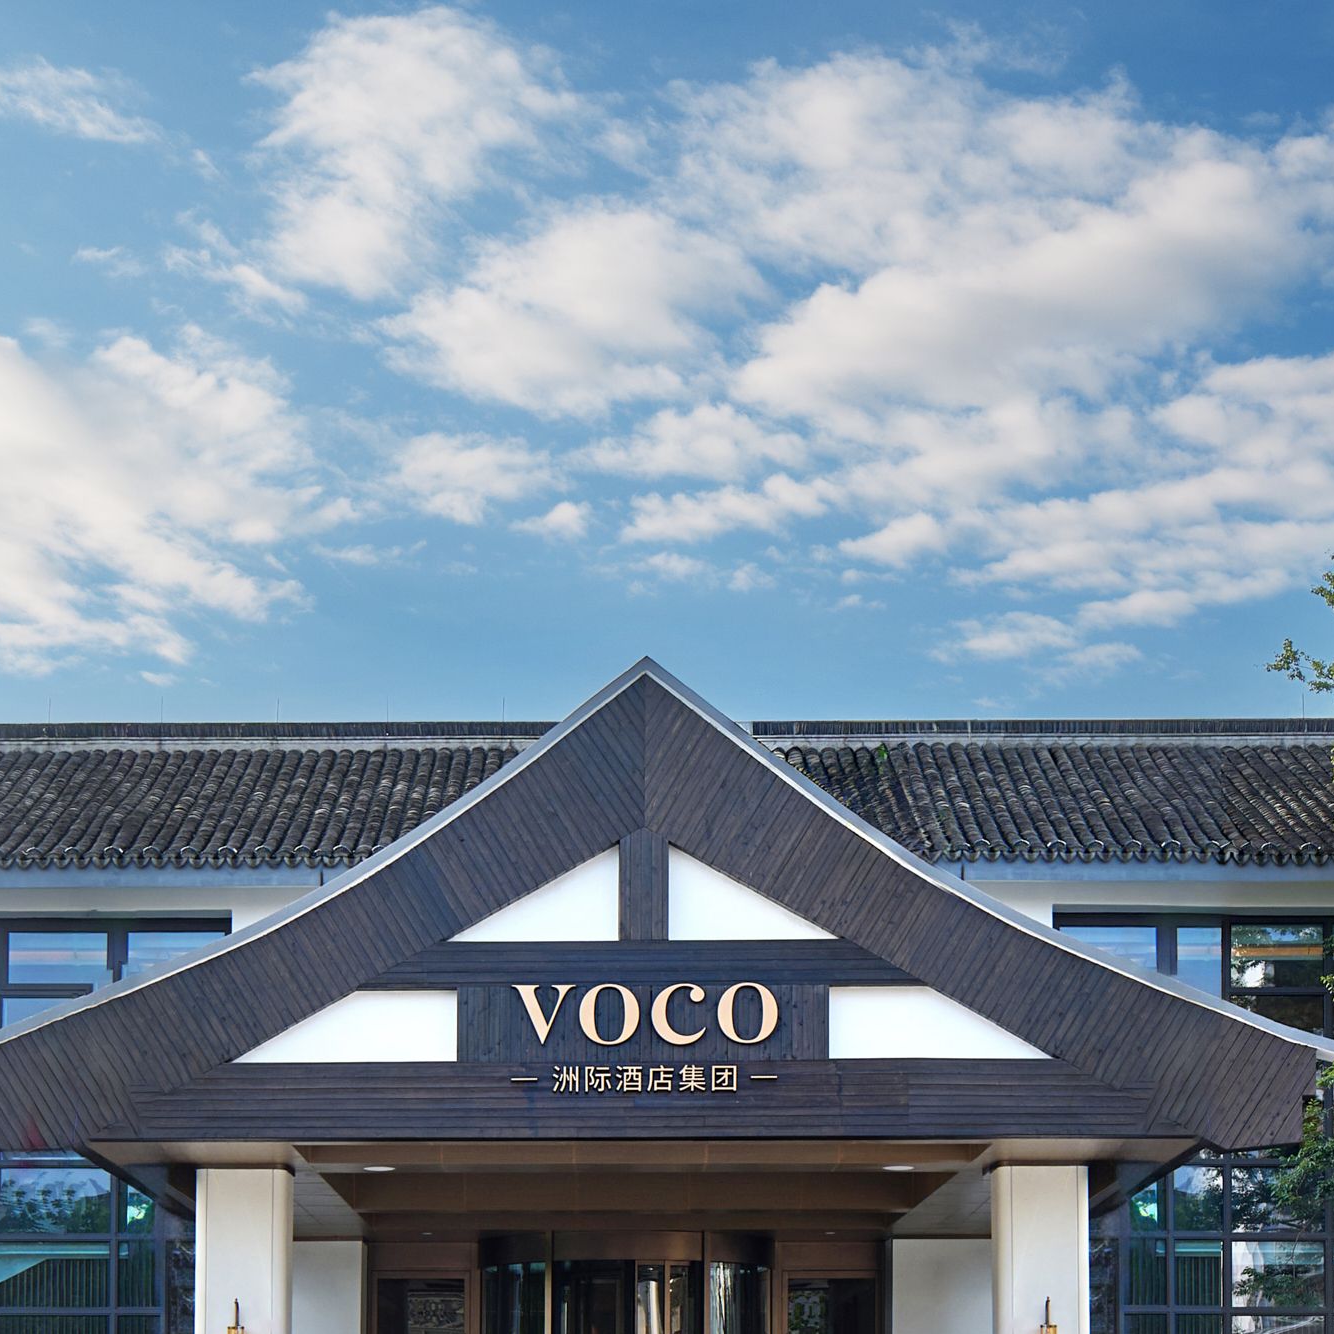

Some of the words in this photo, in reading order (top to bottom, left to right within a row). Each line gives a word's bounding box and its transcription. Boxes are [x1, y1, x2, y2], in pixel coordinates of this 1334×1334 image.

[552, 1064, 738, 1092] 洲际酒店集团
